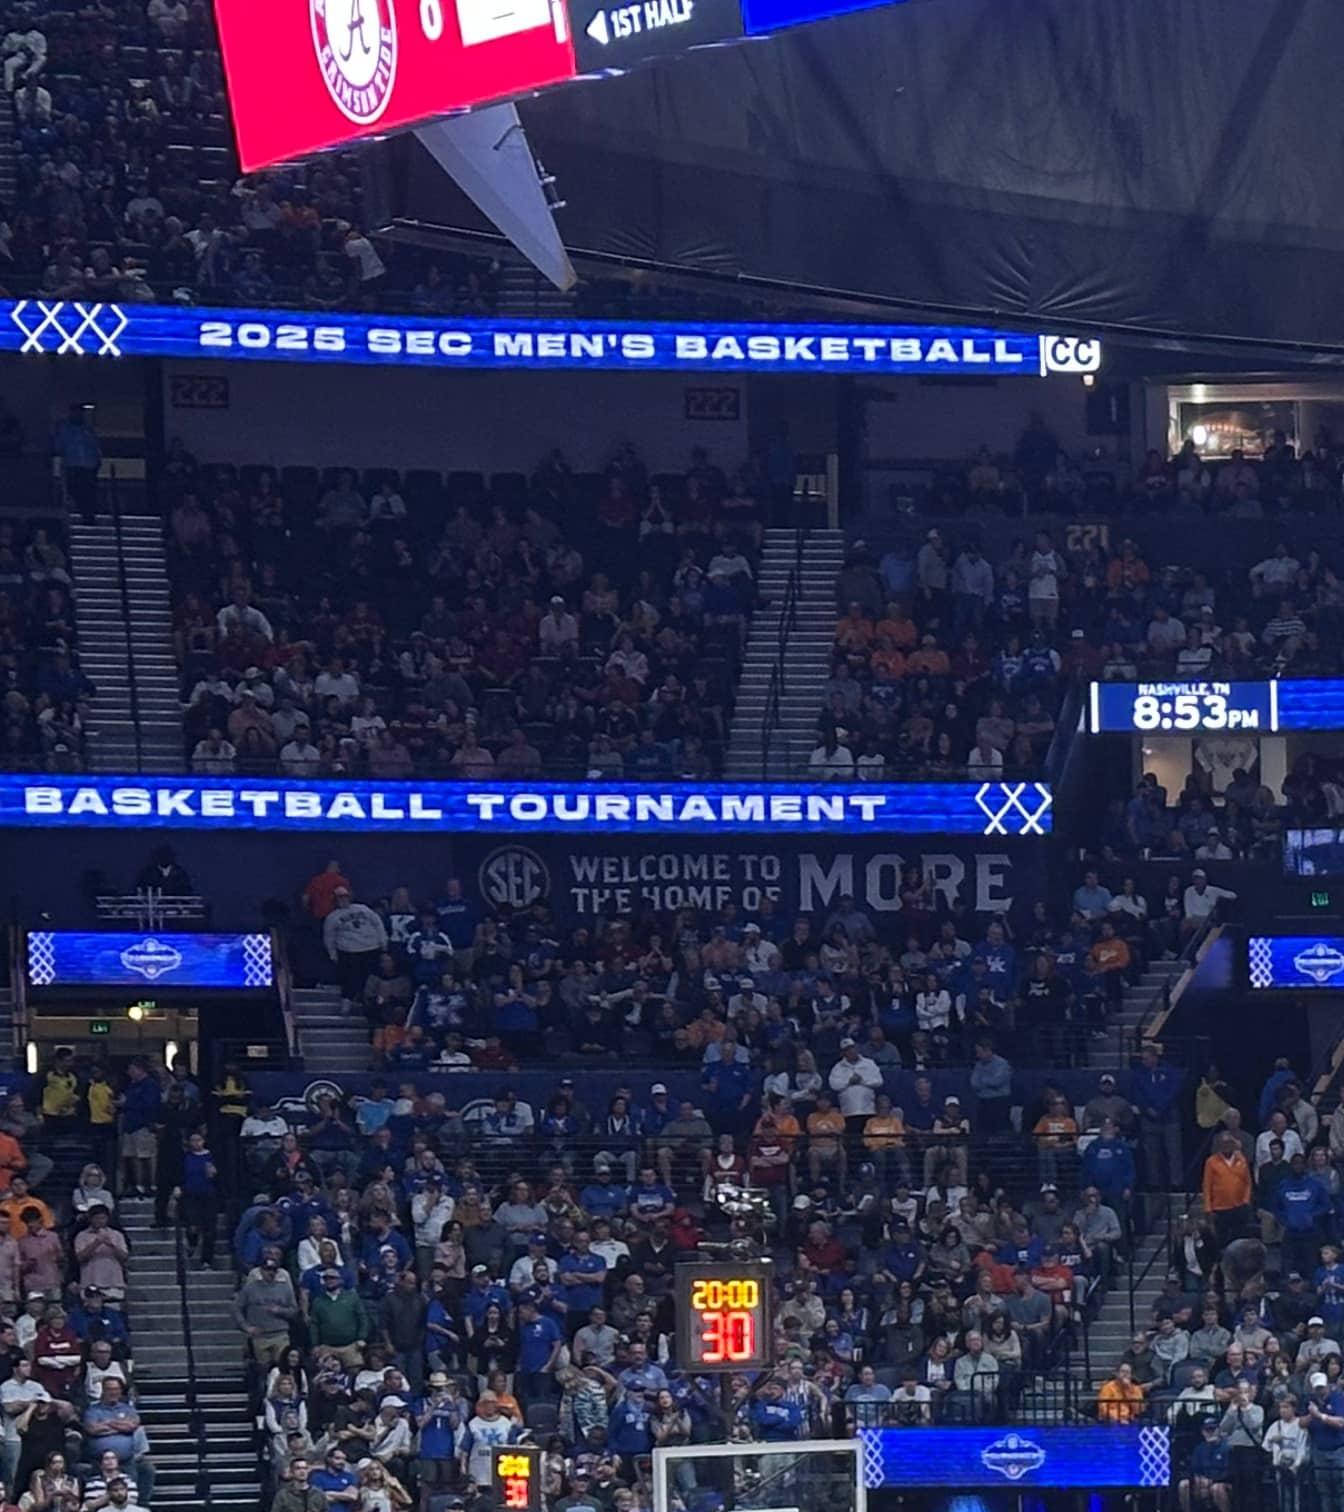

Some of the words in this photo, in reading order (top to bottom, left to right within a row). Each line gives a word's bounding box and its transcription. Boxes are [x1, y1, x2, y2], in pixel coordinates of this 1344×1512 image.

[610, 9, 643, 37] 1ST
[645, 0, 694, 30] HALF
[199, 322, 347, 353] 2025
[367, 328, 473, 357] SEC
[493, 332, 656, 360] MEN'S
[675, 334, 1023, 364] BASKETBALL
[1138, 683, 1211, 697] NASHVILLE,
[1213, 683, 1231, 696] TN
[24, 786, 443, 820] BASKETBALL
[466, 792, 887, 822] TOURNAMENT
[570, 854, 731, 882] WELCOME
[738, 853, 782, 880] TO
[800, 852, 1013, 913] MORE
[692, 1280, 759, 1310] 20:00
[702, 1310, 756, 1362] 30
